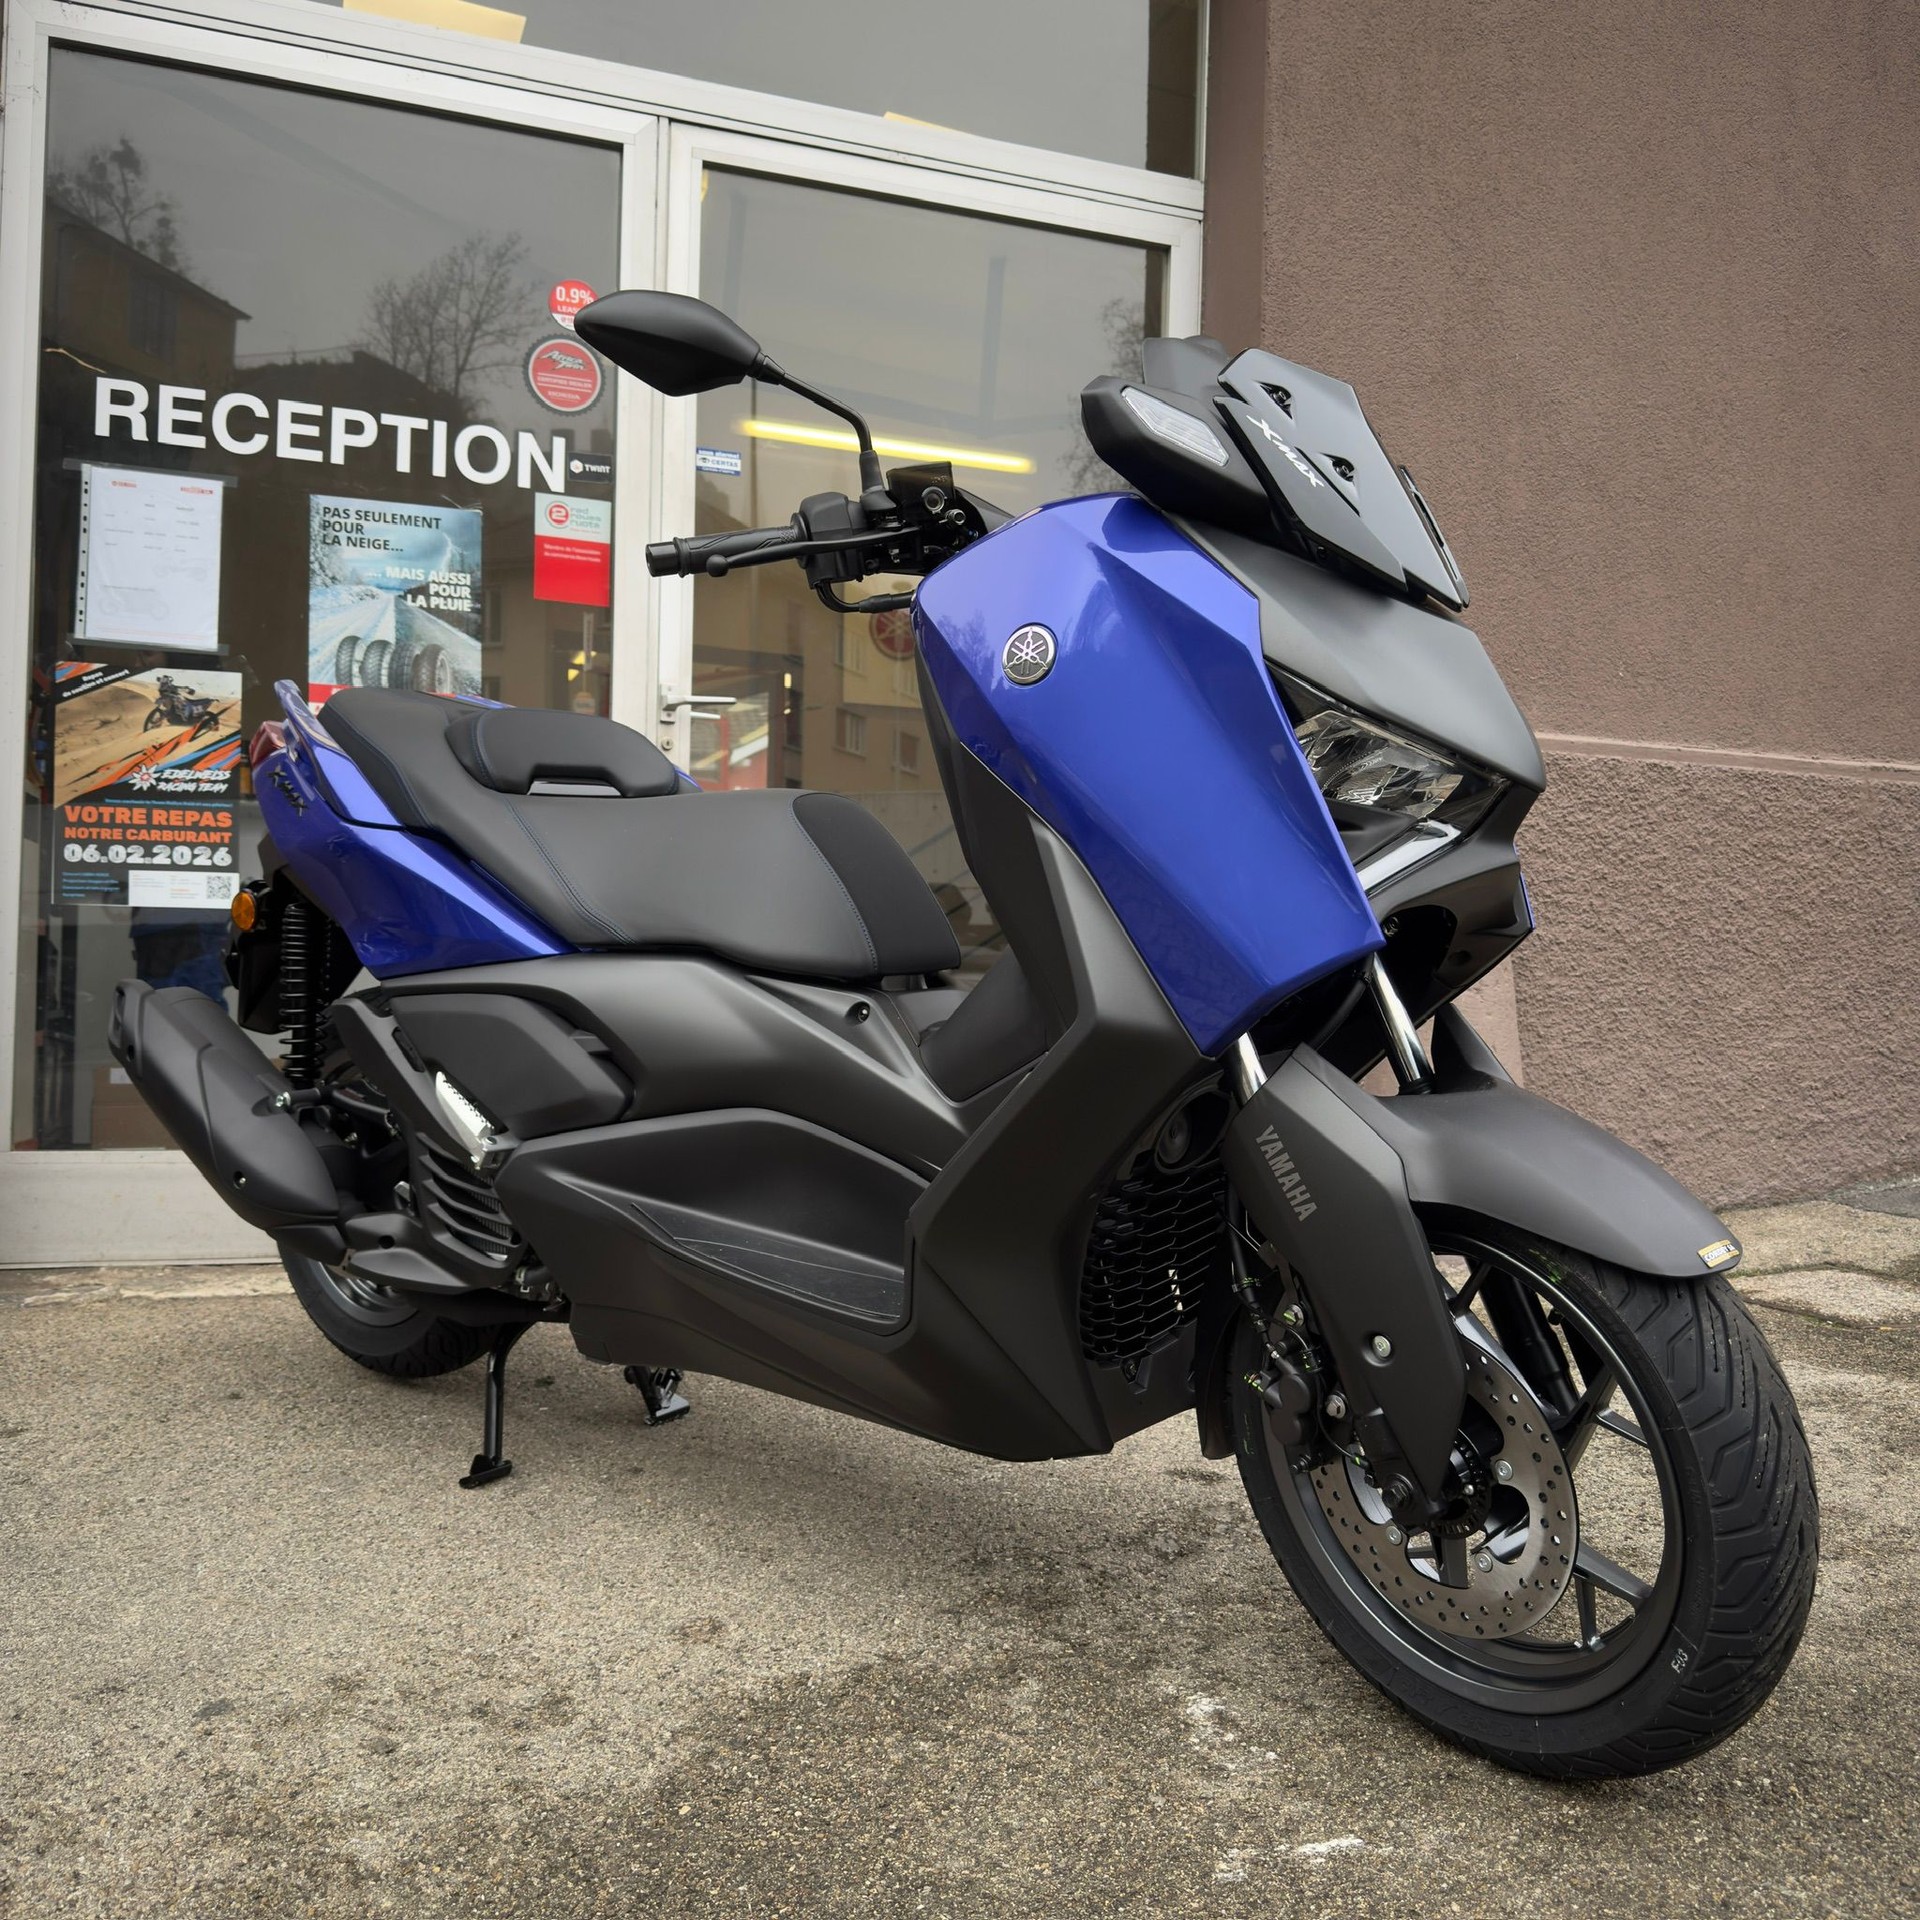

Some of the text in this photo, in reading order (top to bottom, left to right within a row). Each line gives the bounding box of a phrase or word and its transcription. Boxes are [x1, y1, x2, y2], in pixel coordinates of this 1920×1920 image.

[555, 285, 594, 305] 0.9%
[557, 304, 580, 315] LEAS
[94, 376, 566, 493] RECEPTION
[323, 506, 442, 530] PAS SEULEMENT
[322, 520, 364, 535] POUR
[322, 534, 404, 552] LA NEIGE...
[385, 566, 425, 581] MAIS
[428, 571, 471, 586] AUSSI
[429, 583, 471, 599] POUR
[406, 594, 472, 612] LA PLUIE
[161, 768, 232, 781] EDELWEISS
[157, 781, 228, 793] RACING TEAM
[63, 805, 232, 827] VOTRE REPAS
[64, 827, 232, 843] NOTRE CARBURANT
[63, 843, 232, 867] 06.02.2026
[1256, 1125, 1318, 1222] YAMAHA
